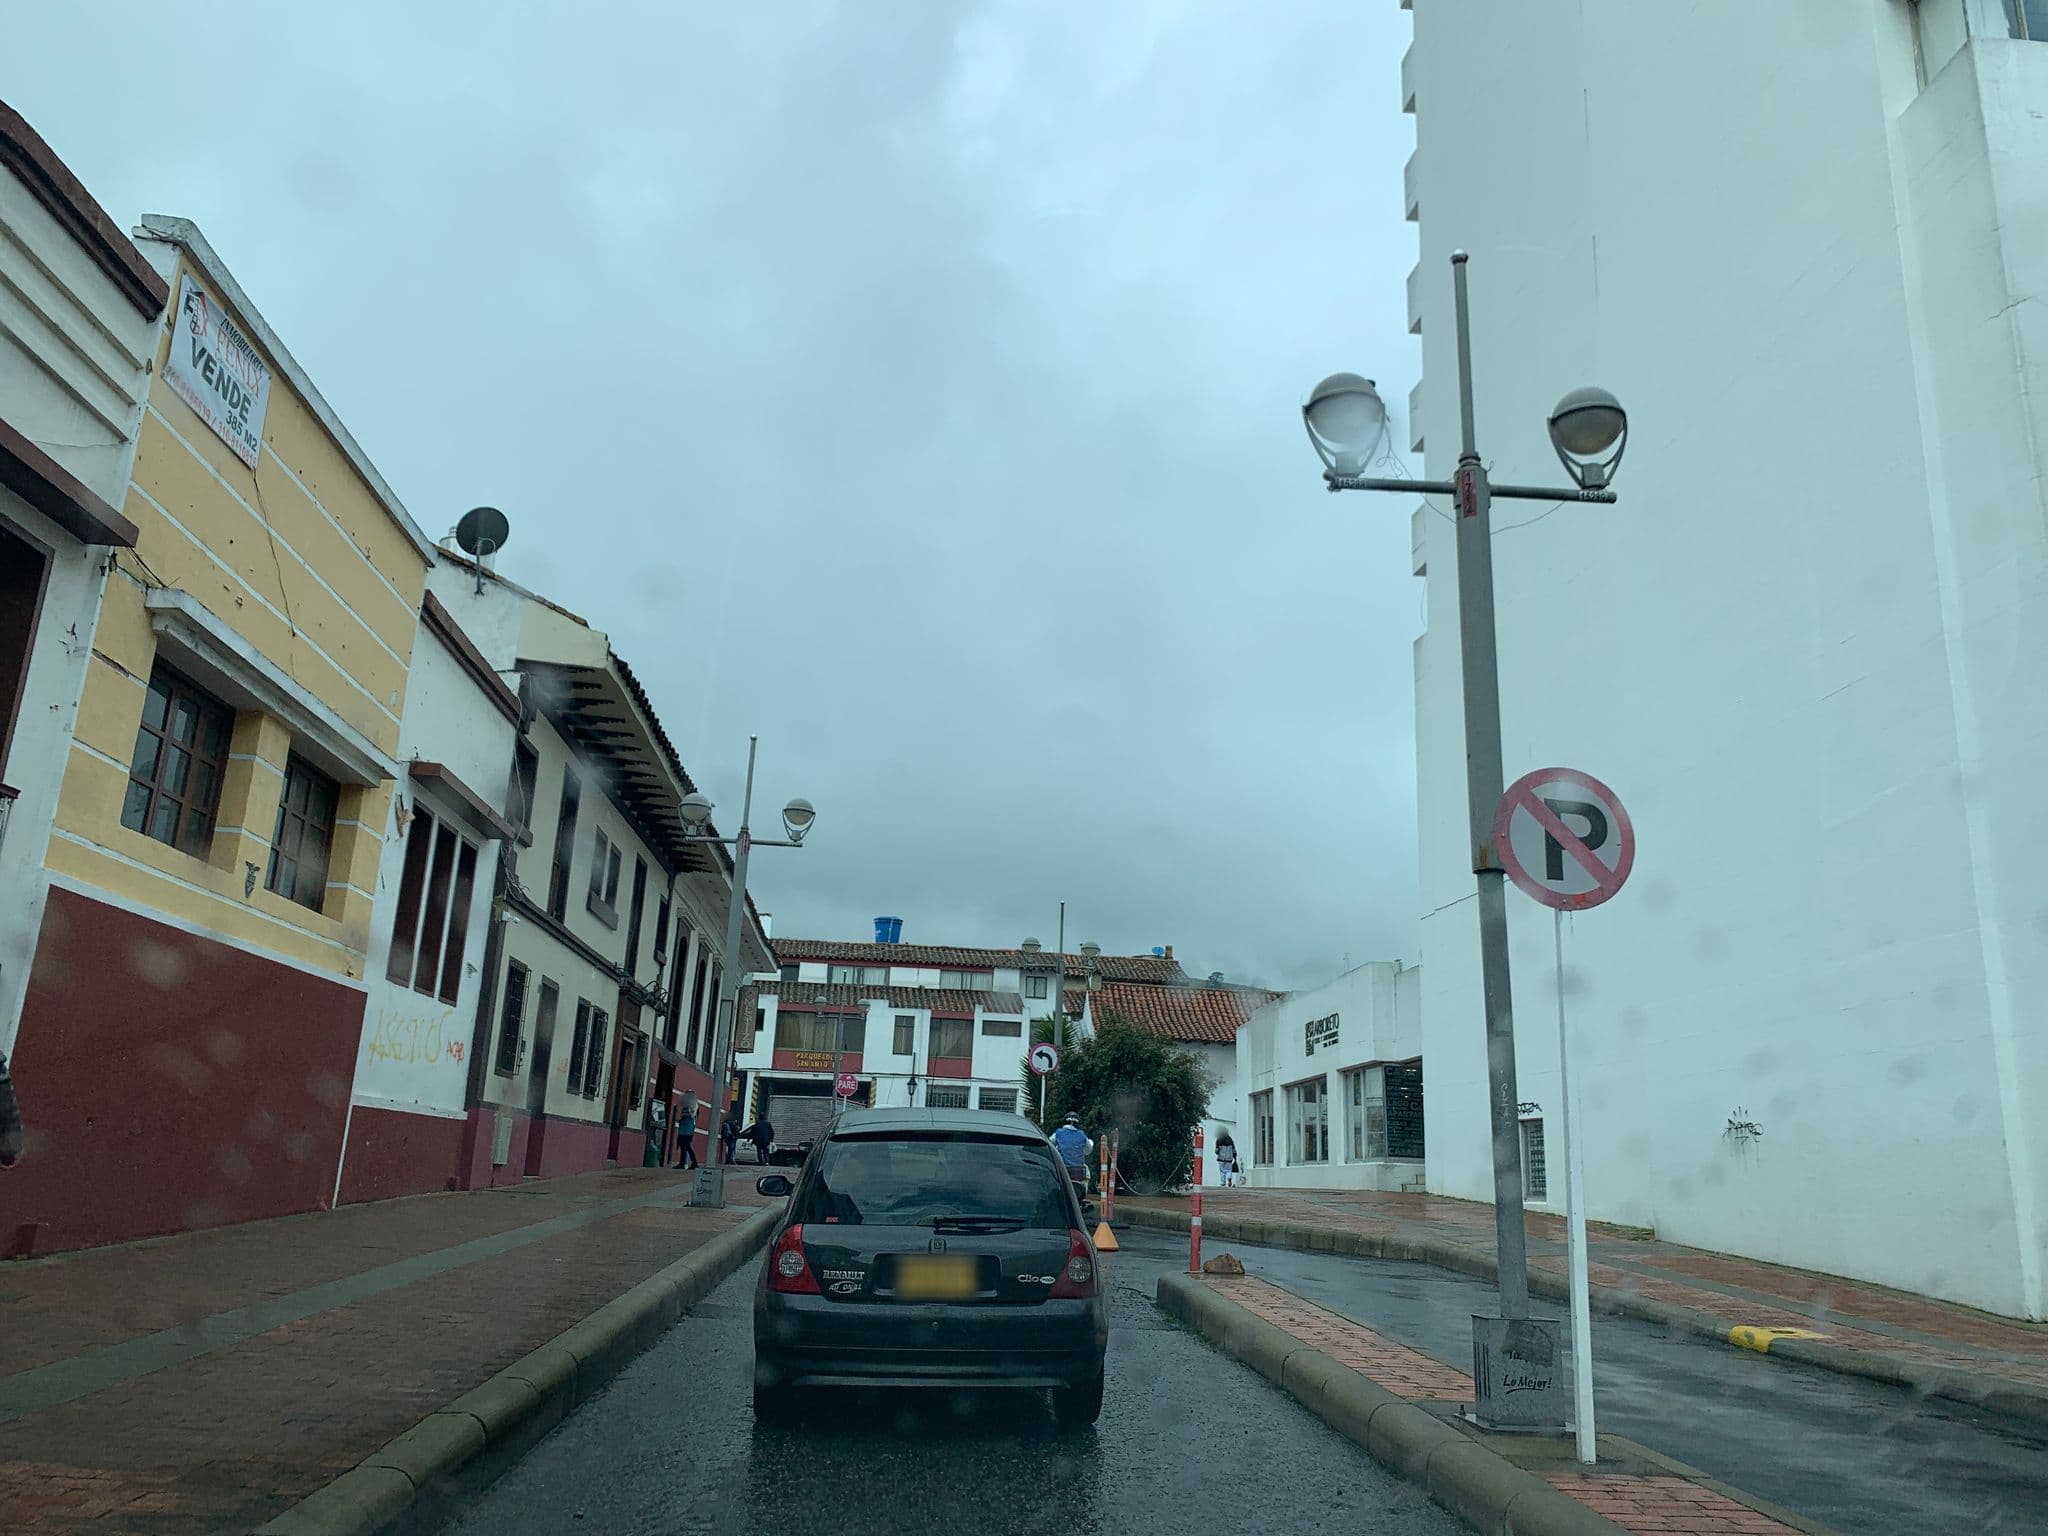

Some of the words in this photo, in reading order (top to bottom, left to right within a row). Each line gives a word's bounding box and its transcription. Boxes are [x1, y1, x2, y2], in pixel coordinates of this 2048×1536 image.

[191, 336, 252, 424] VENDE
[225, 409, 243, 436] 385
[243, 429, 258, 453] M2
[1543, 797, 1608, 881] P
[1313, 1012, 1340, 1037] ARBORETO
[838, 1080, 856, 1090] PARE
[823, 1269, 865, 1280] RENAULT
[1017, 1273, 1040, 1283] Clio
